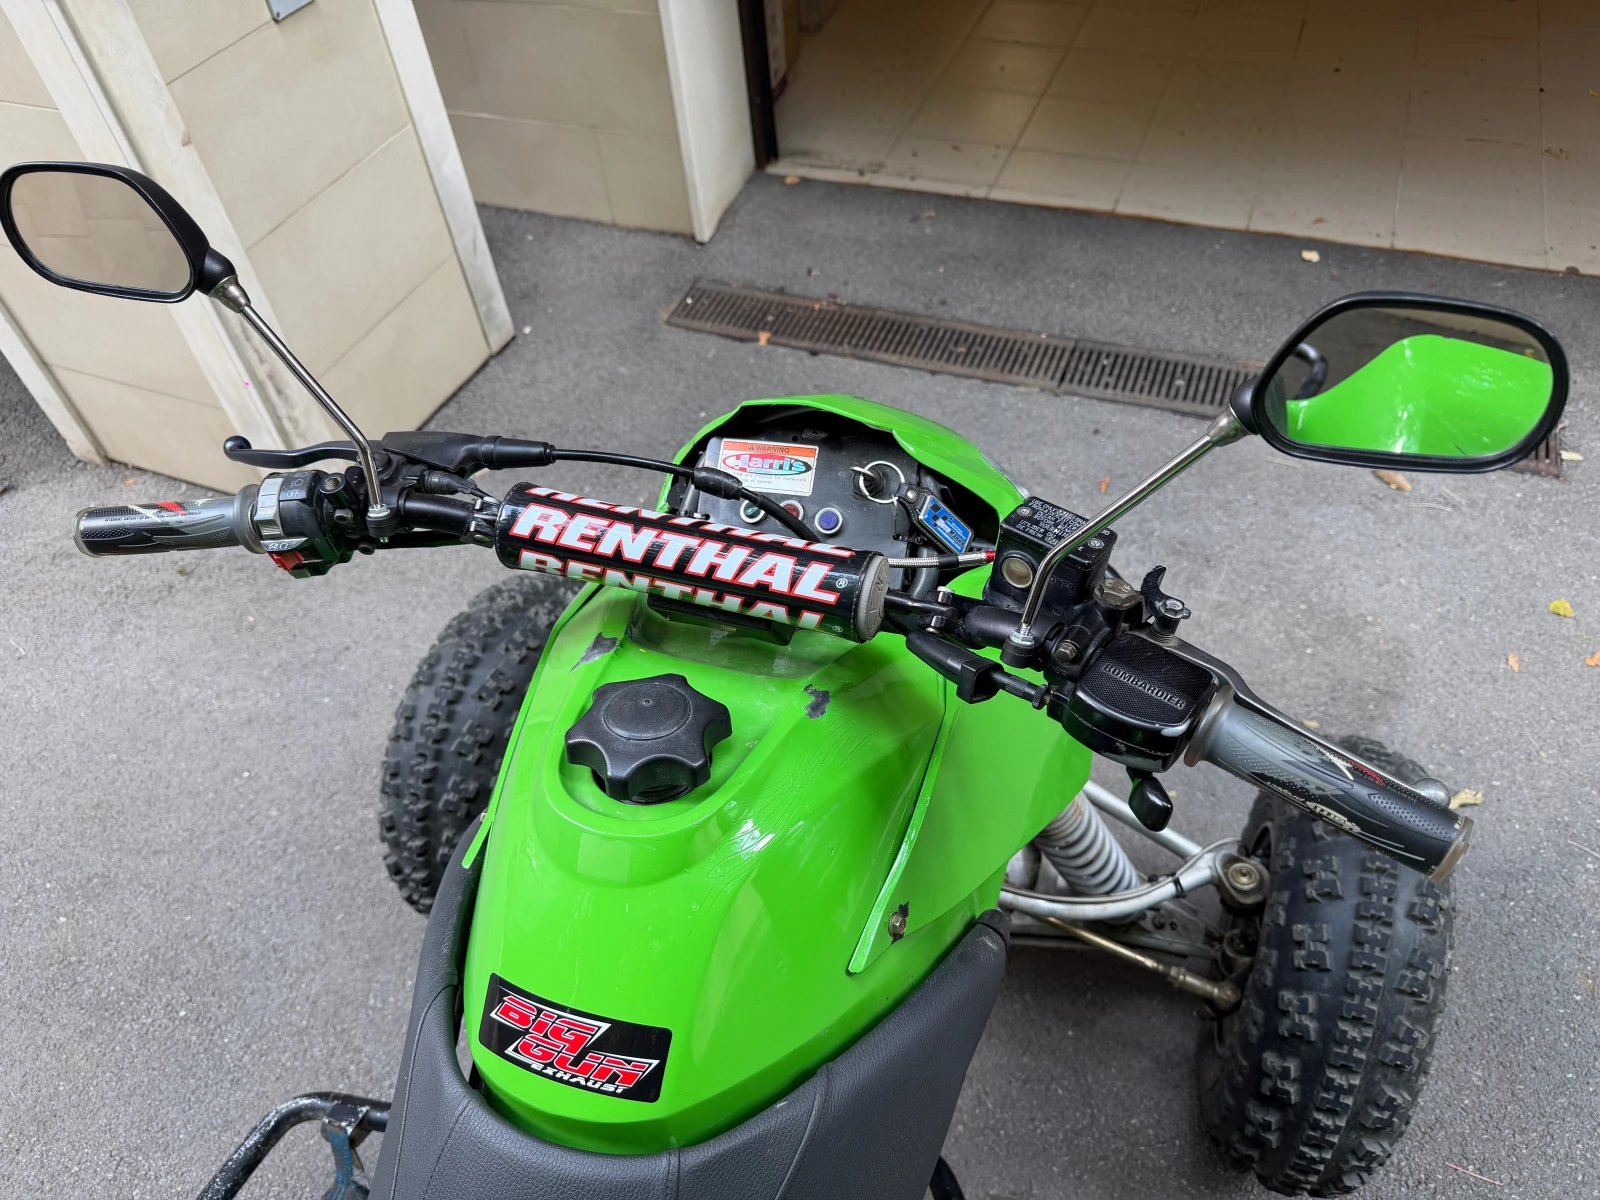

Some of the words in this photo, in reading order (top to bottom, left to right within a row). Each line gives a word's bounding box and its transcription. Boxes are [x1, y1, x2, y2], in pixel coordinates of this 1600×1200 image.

[1039, 521, 1069, 537] WARNIN
[508, 502, 841, 606] RENTHAL
[1101, 663, 1186, 710] BOMBARDIER
[530, 1062, 631, 1094] EXHAUST
